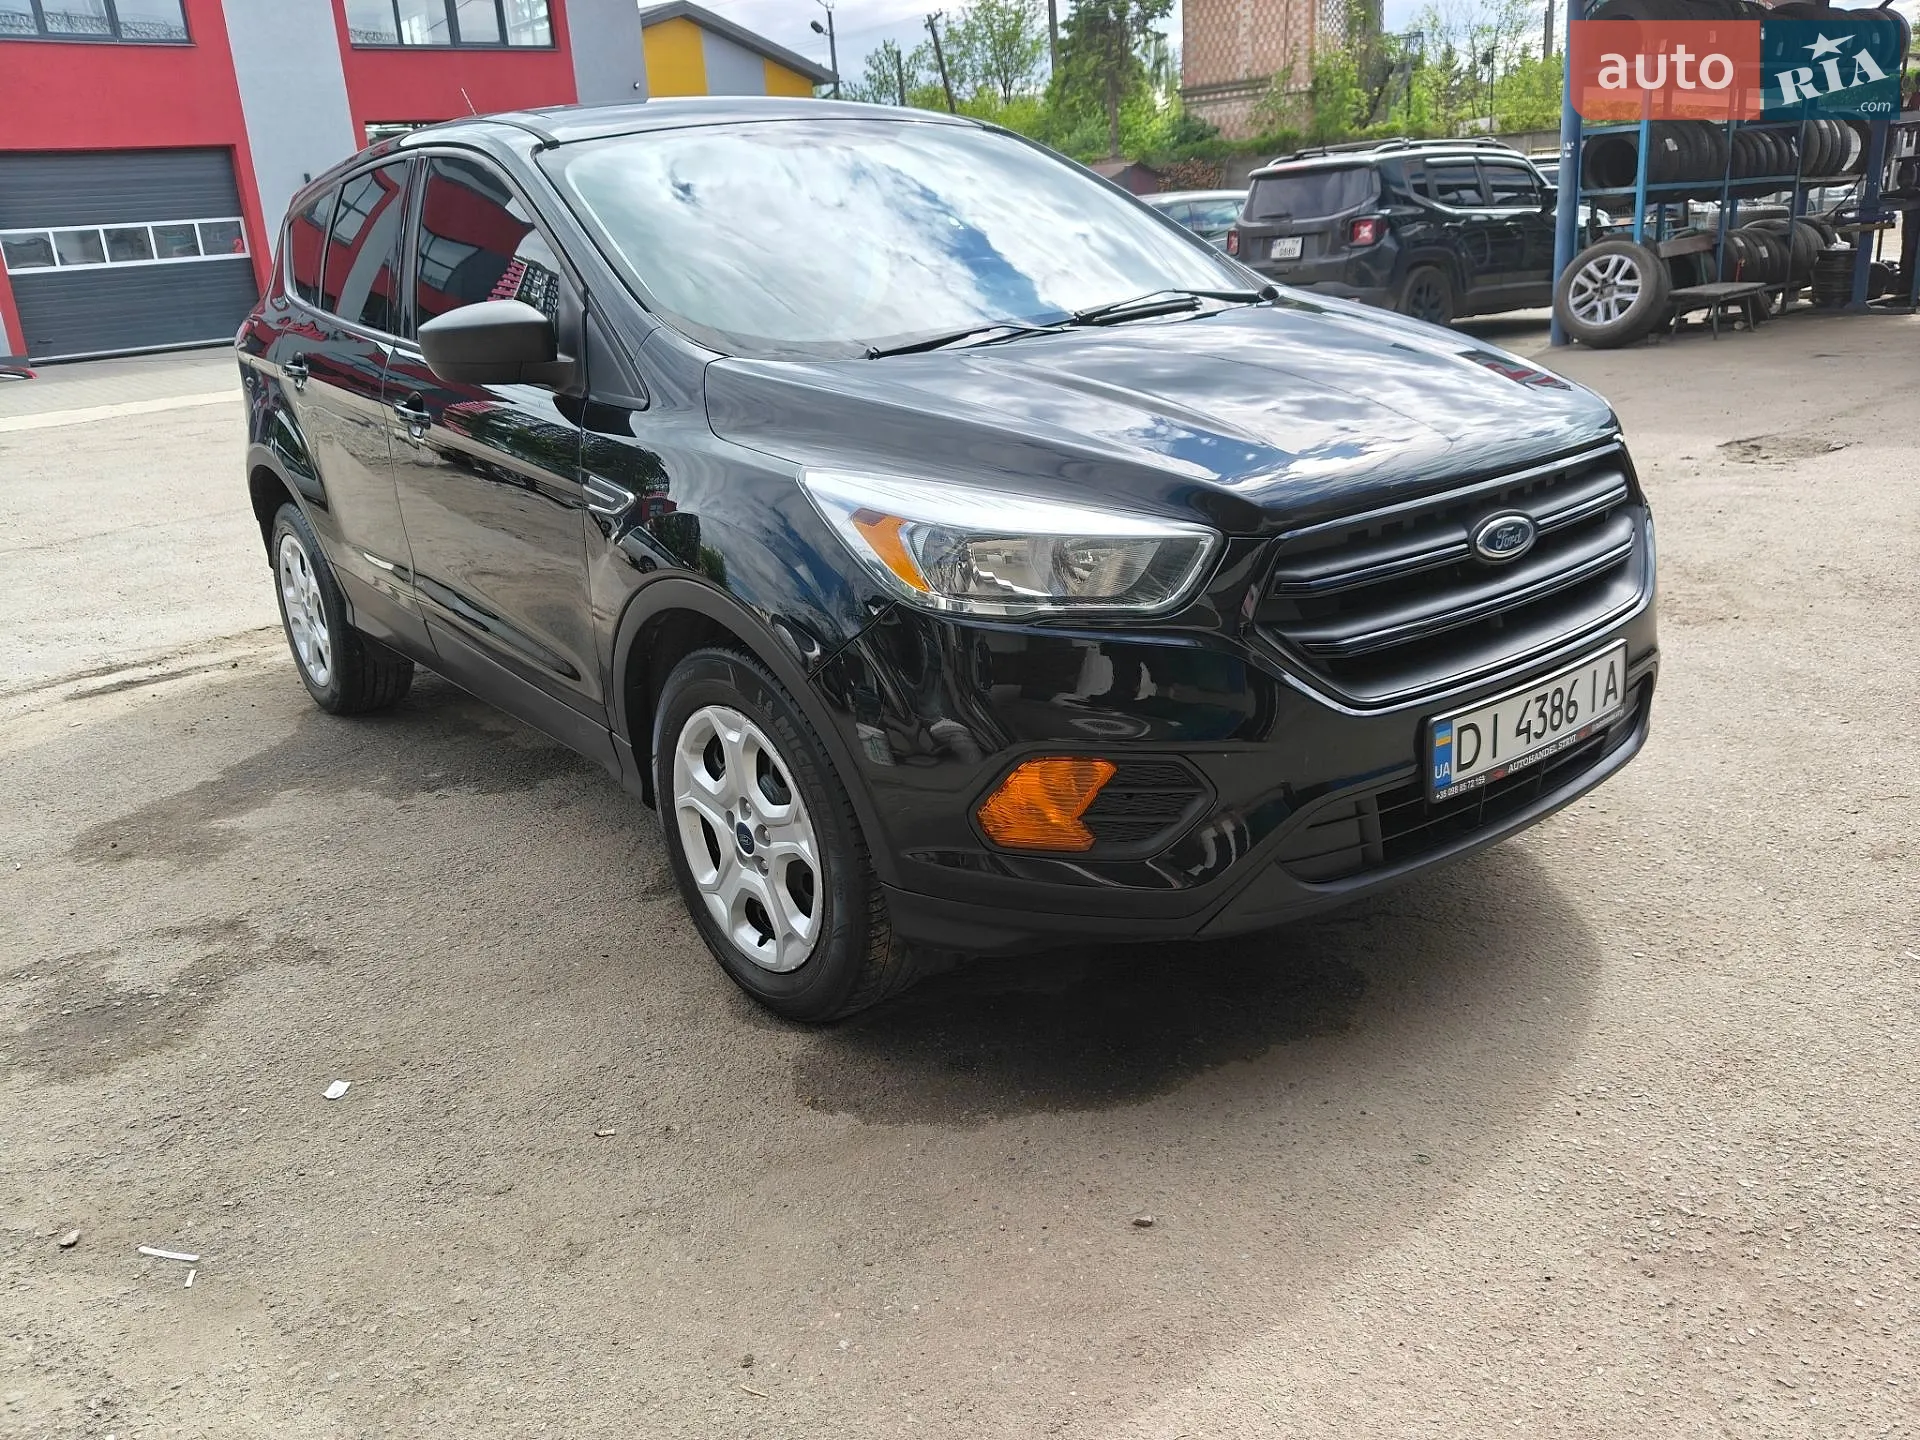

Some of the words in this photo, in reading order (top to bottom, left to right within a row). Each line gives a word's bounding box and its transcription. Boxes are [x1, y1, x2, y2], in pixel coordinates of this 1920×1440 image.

[1495, 526, 1523, 550] Ford
[1456, 713, 1499, 773] DI
[1515, 678, 1579, 745] 4386
[1591, 660, 1619, 714] IA
[1434, 762, 1450, 779] UA
[1508, 745, 1557, 773] AUTOHANDEL
